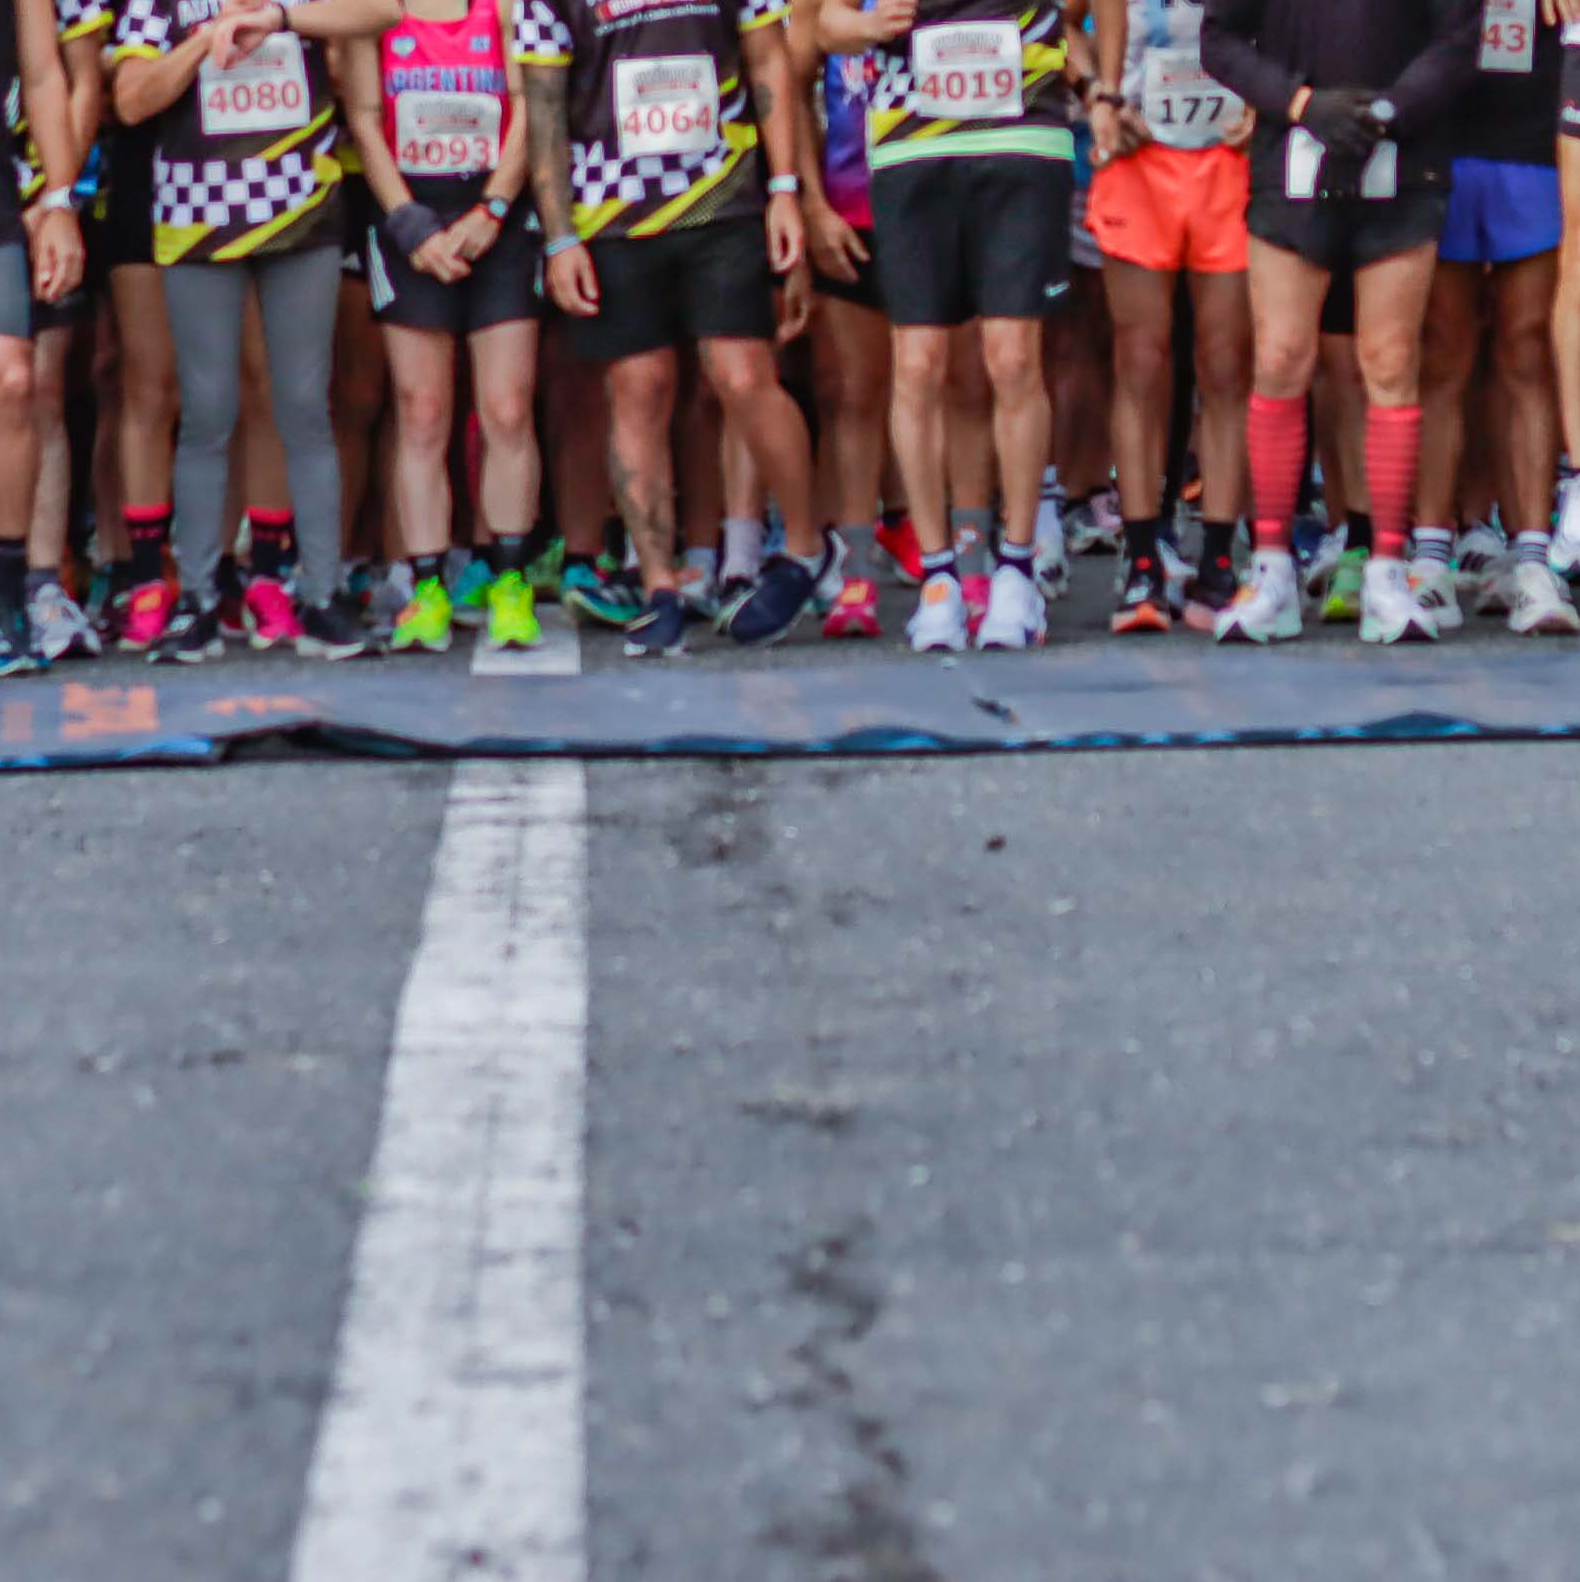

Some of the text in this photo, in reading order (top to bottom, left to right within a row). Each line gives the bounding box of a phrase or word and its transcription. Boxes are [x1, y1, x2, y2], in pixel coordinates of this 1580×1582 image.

[1483, 22, 1526, 53] 43
[208, 79, 302, 114] 4080
[921, 69, 1016, 100] 4019
[624, 102, 712, 136] 4064
[1160, 96, 1226, 125] 177
[402, 135, 491, 168] 4093
